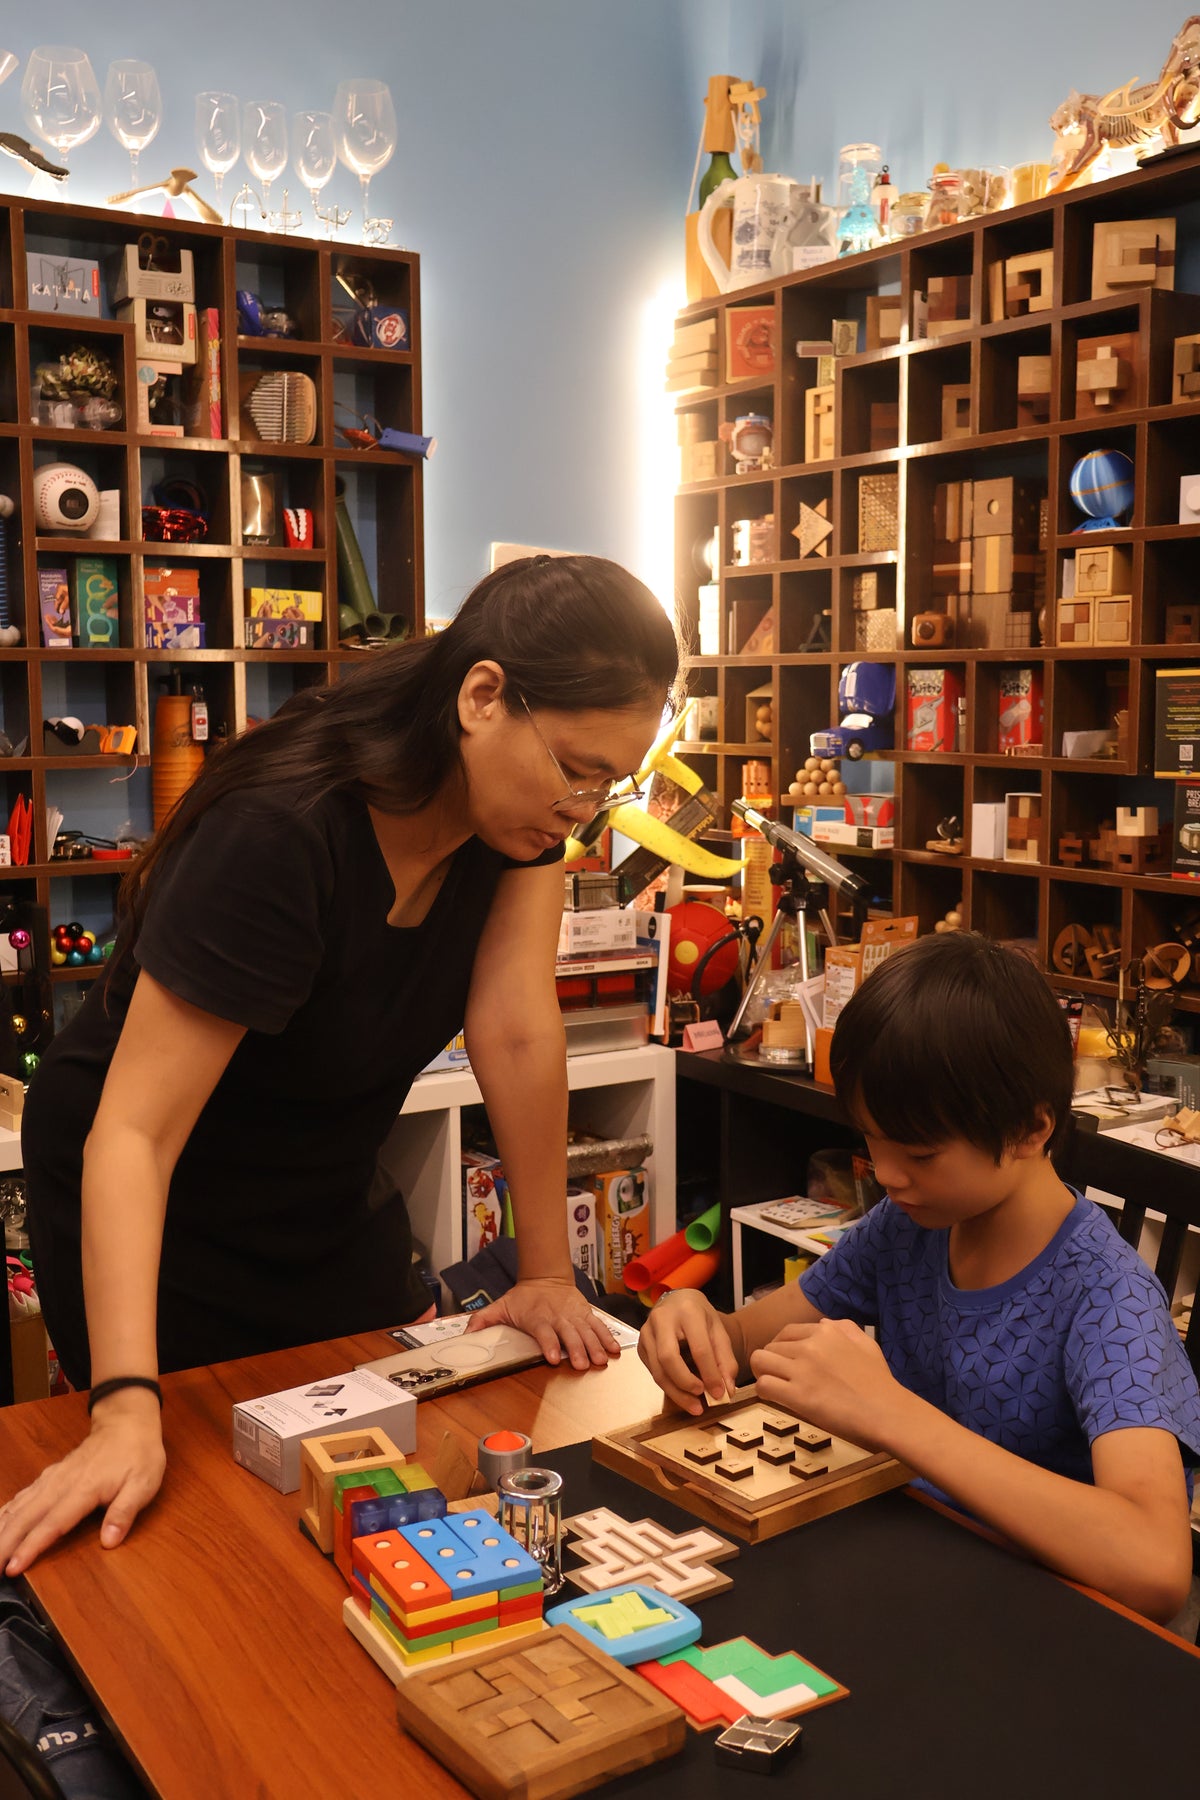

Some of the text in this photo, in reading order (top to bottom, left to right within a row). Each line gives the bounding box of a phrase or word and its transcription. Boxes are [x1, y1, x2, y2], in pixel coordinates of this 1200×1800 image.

[1187, 798, 1200, 808] BRE
[611, 1215, 621, 1248] ENERGY
[581, 1243, 589, 1271] BES
[465, 1298, 485, 1312] THE
